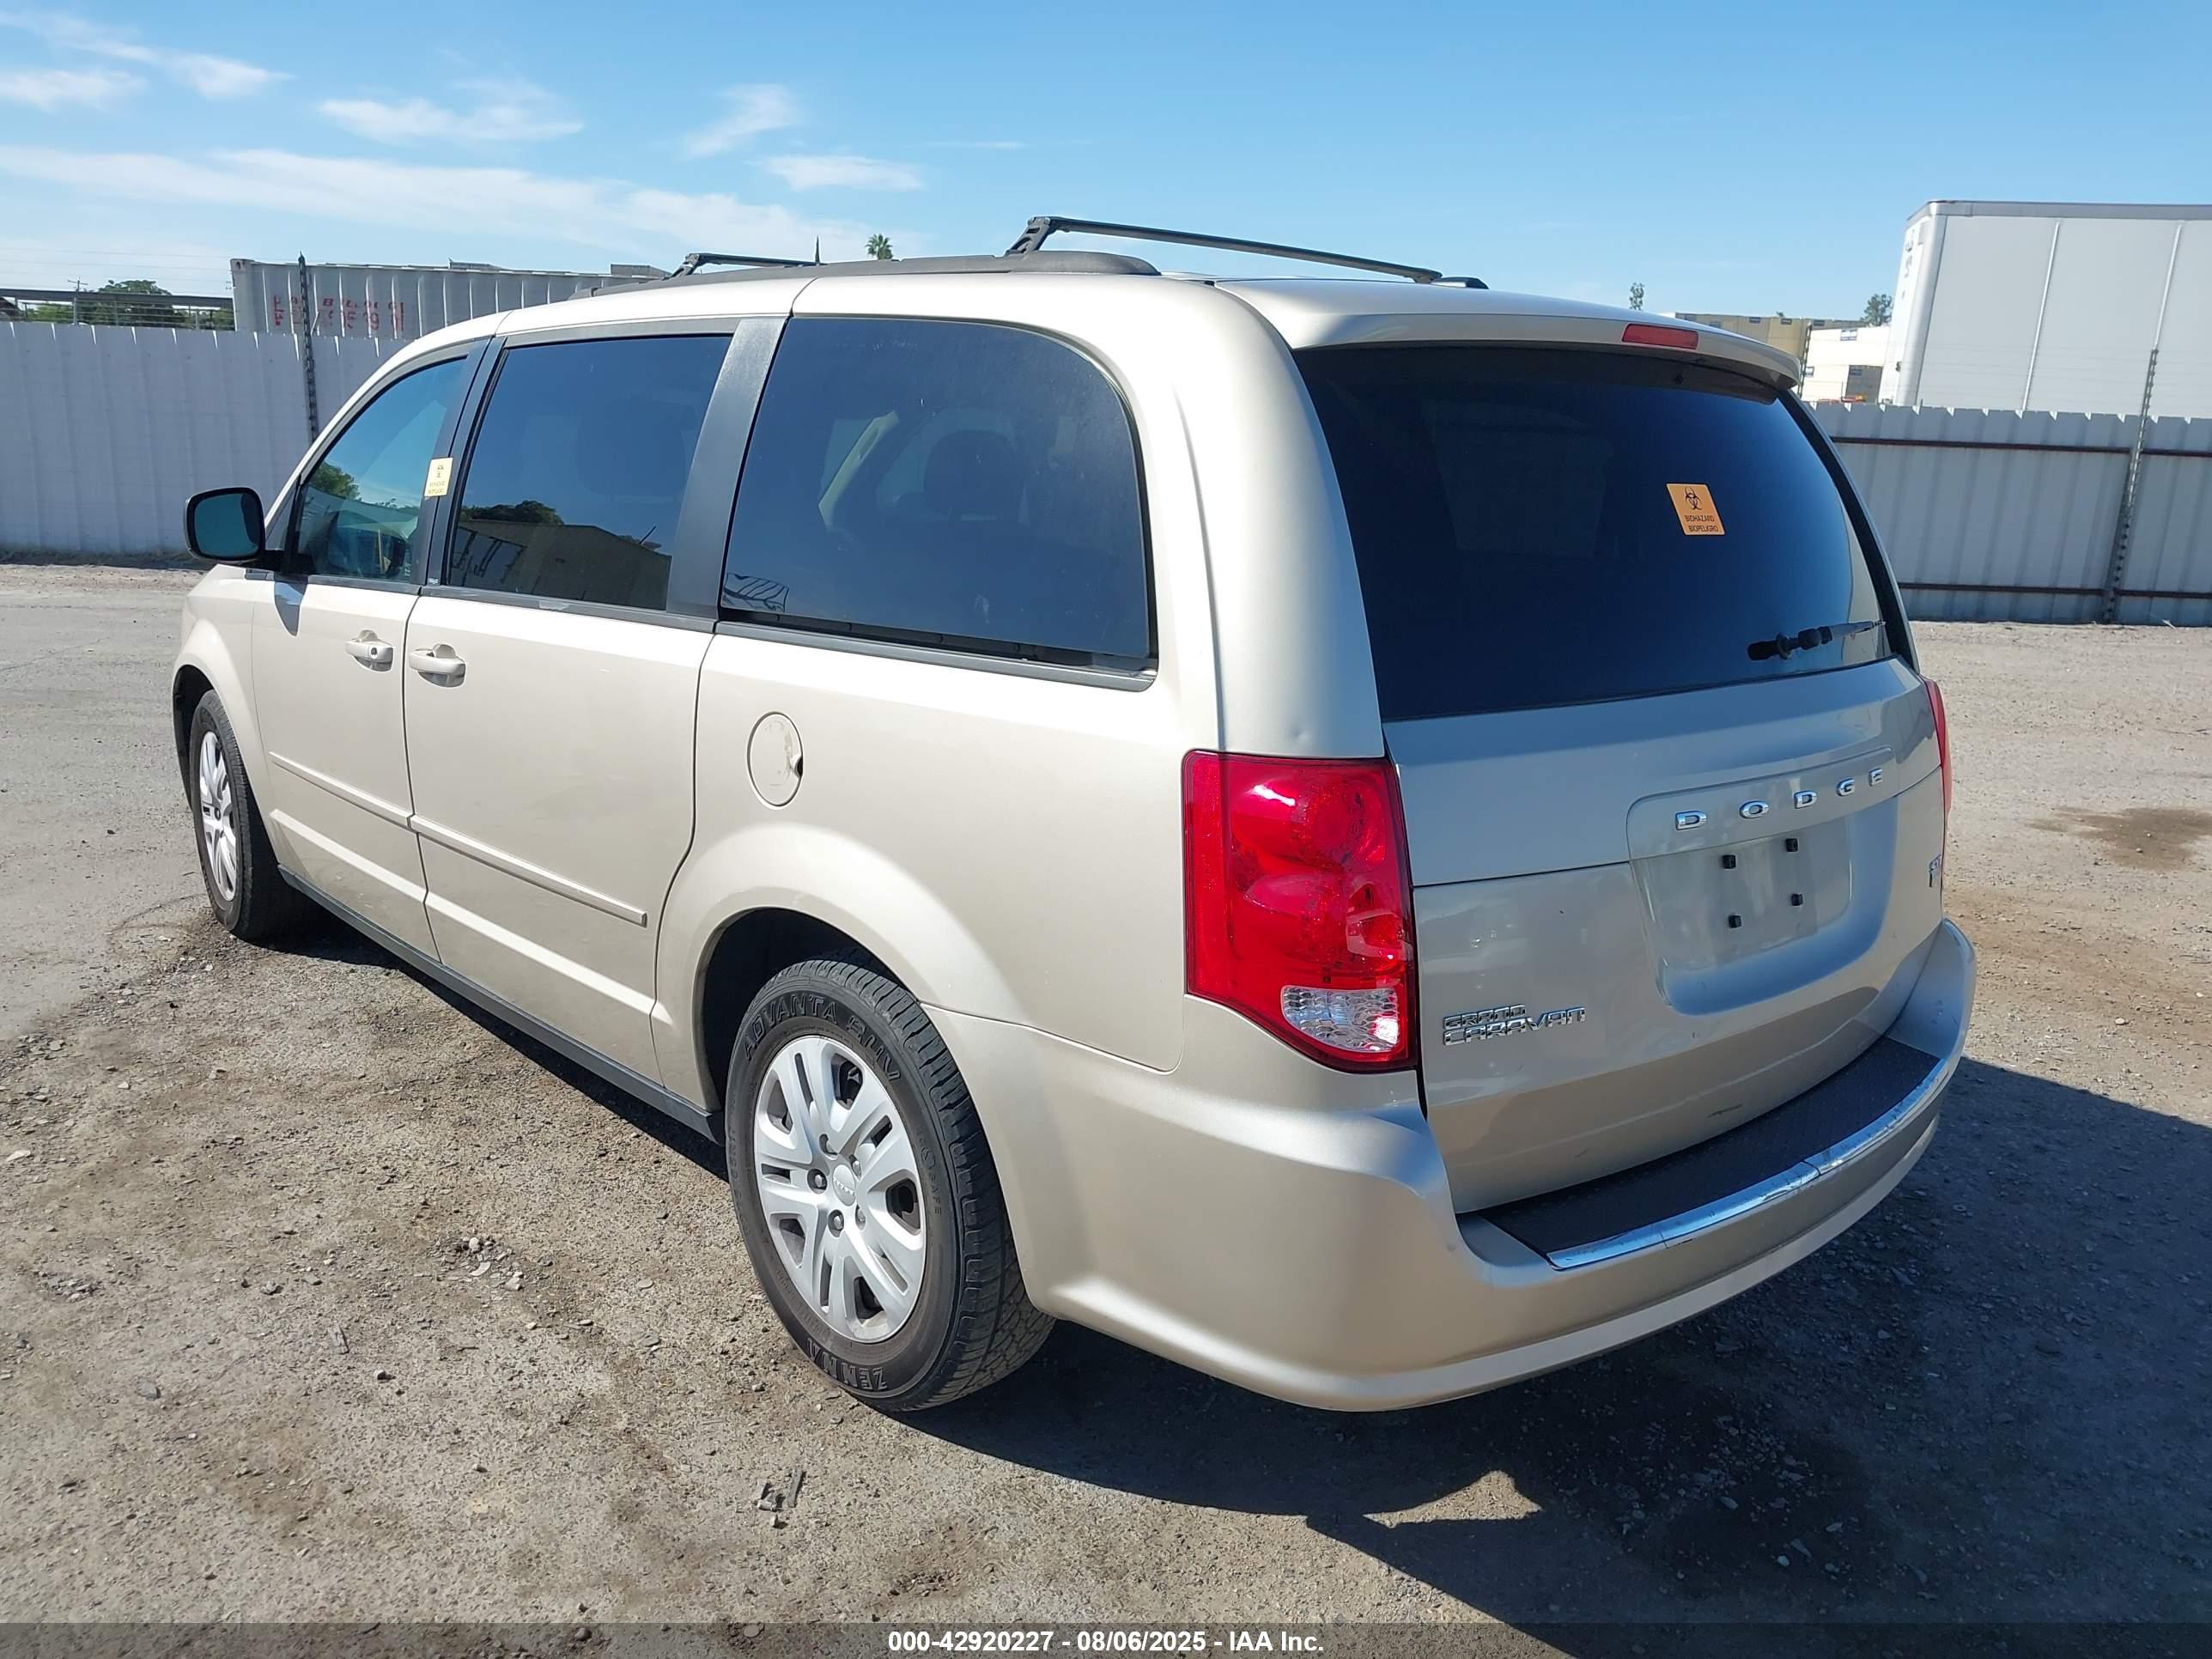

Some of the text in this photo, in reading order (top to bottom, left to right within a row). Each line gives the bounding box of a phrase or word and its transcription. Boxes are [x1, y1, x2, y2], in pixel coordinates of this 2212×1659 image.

[1675, 769, 1883, 831] DODGE
[744, 993, 840, 1061] ADVANTA
[1443, 1004, 1526, 1030] GRAND
[1443, 1006, 1587, 1046] CARAVAN
